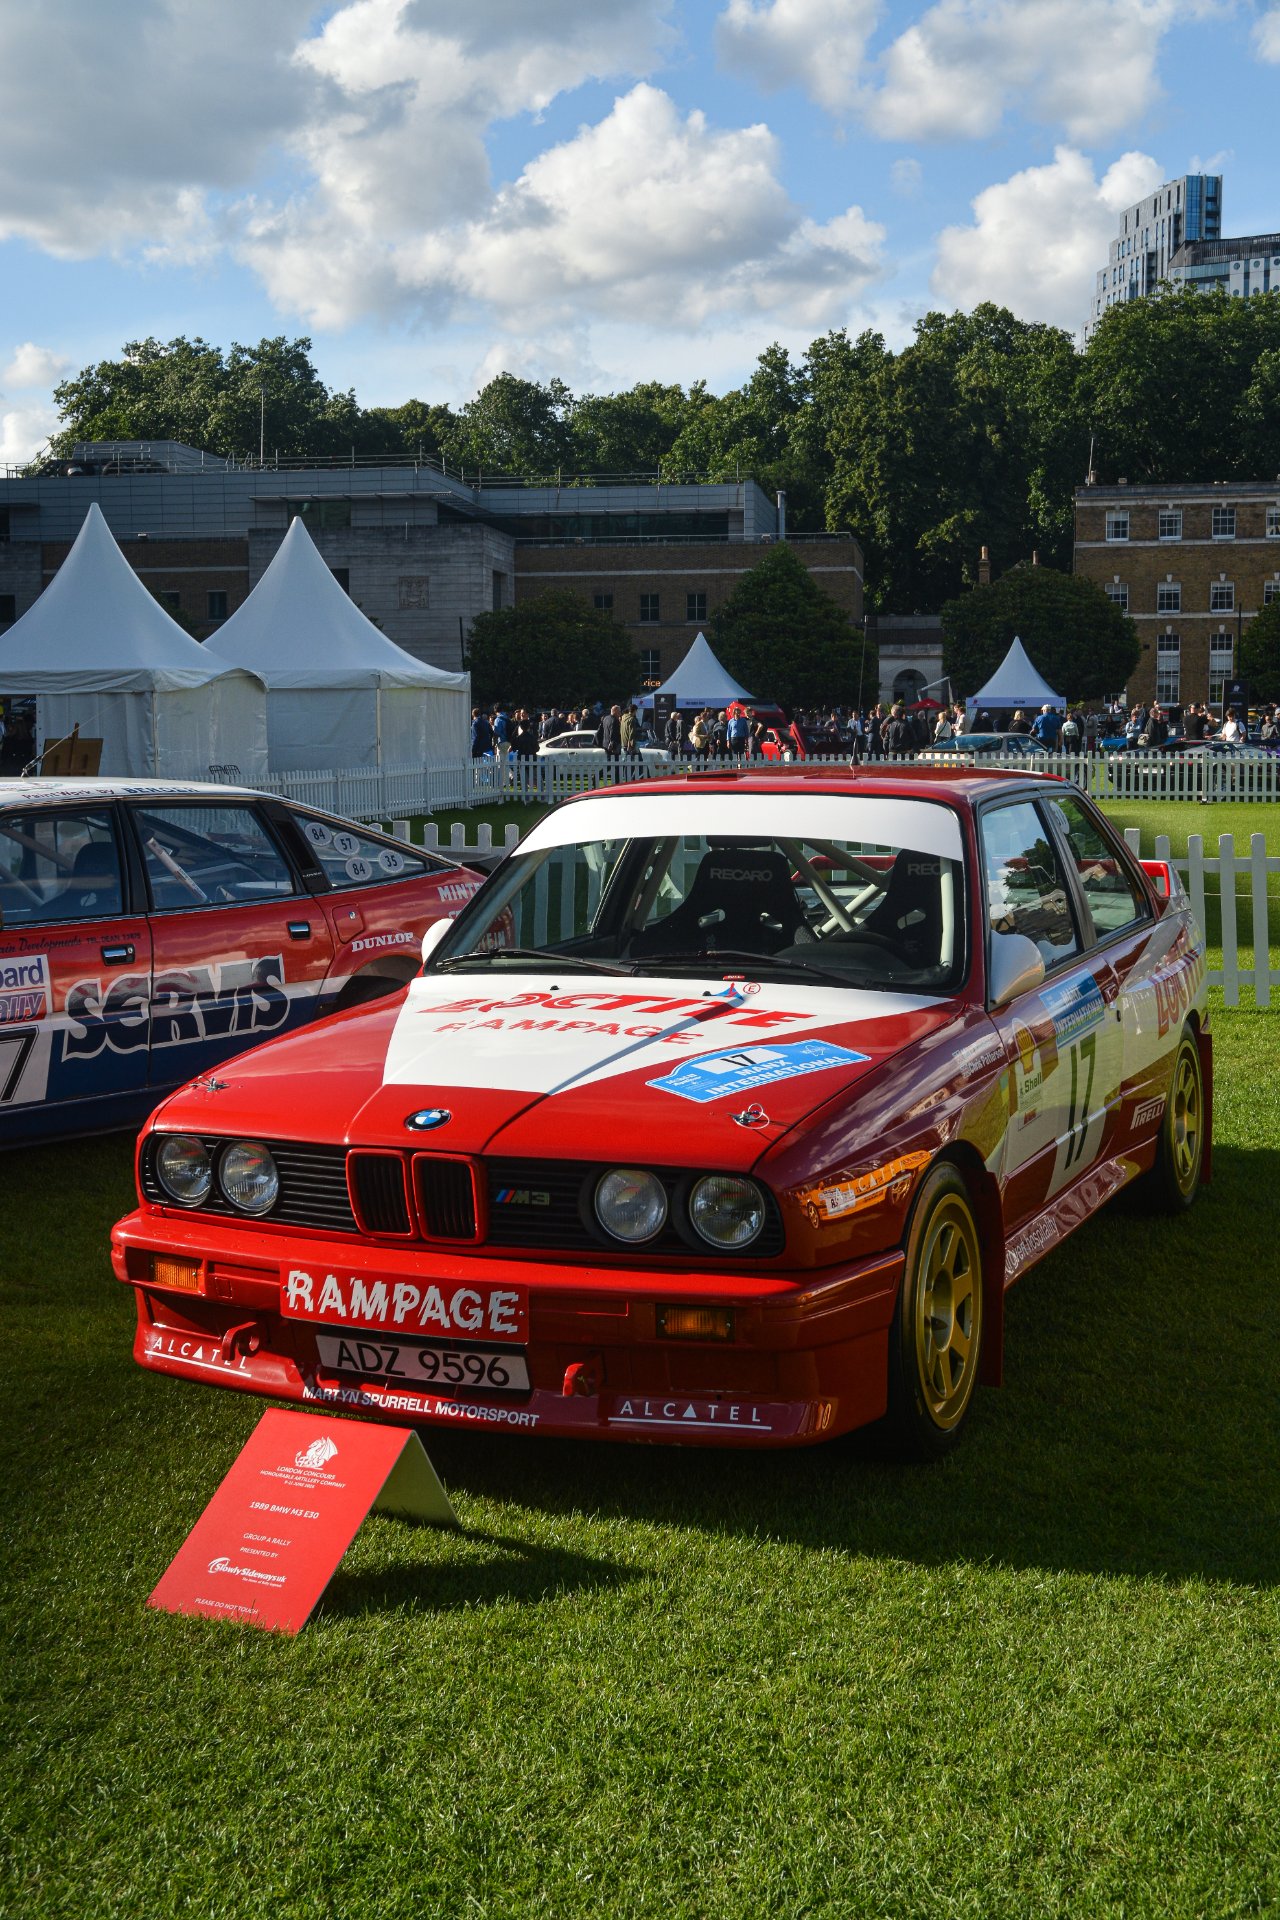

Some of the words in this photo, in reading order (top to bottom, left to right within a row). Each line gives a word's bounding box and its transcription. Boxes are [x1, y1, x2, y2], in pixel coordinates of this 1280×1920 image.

[311, 828, 326, 840] 84
[341, 838, 352, 851] 57
[352, 862, 366, 875] 84
[384, 855, 398, 867] 35
[710, 867, 773, 882] RECARO
[352, 932, 414, 952] DUNLOP
[61, 953, 291, 1063] SERVIS
[416, 992, 819, 1029] LOCTITE
[435, 1018, 704, 1046] RAMPAGE
[719, 1053, 757, 1067] 17
[734, 1059, 794, 1077] MANX
[704, 1056, 850, 1095] INTERNATIONAL
[1024, 1072, 1042, 1093] Shell
[1064, 1031, 1096, 1170] 17
[1130, 1092, 1167, 1130] PIRELLI
[511, 1190, 550, 1206] M3
[286, 1270, 519, 1333] RAMPAGE
[336, 1340, 406, 1376] ADZ
[418, 1349, 510, 1387] 9596
[302, 1386, 359, 1403] MARTYN
[361, 1391, 432, 1413] SPURRELL
[434, 1401, 540, 1428] MOTORSPORT
[620, 1400, 761, 1422] ALCATEL
[260, 1469, 294, 1480] HONOURABLE
[294, 1475, 320, 1484] ARTILLERY
[320, 1479, 346, 1489] COMPANY
[277, 1465, 303, 1475] LONDON
[303, 1470, 336, 1480] CONCOURS
[250, 1501, 270, 1511] 1989
[270, 1504, 291, 1515] BMW
[290, 1507, 304, 1517] M3
[303, 1509, 319, 1519] E30
[243, 1532, 267, 1541] GROUP
[271, 1537, 292, 1547] RALLY
[240, 1546, 271, 1558] PRESENTED
[195, 1597, 215, 1607] PLEASE
[224, 1603, 239, 1611] NOT
[238, 1605, 259, 1615] TOUCH
